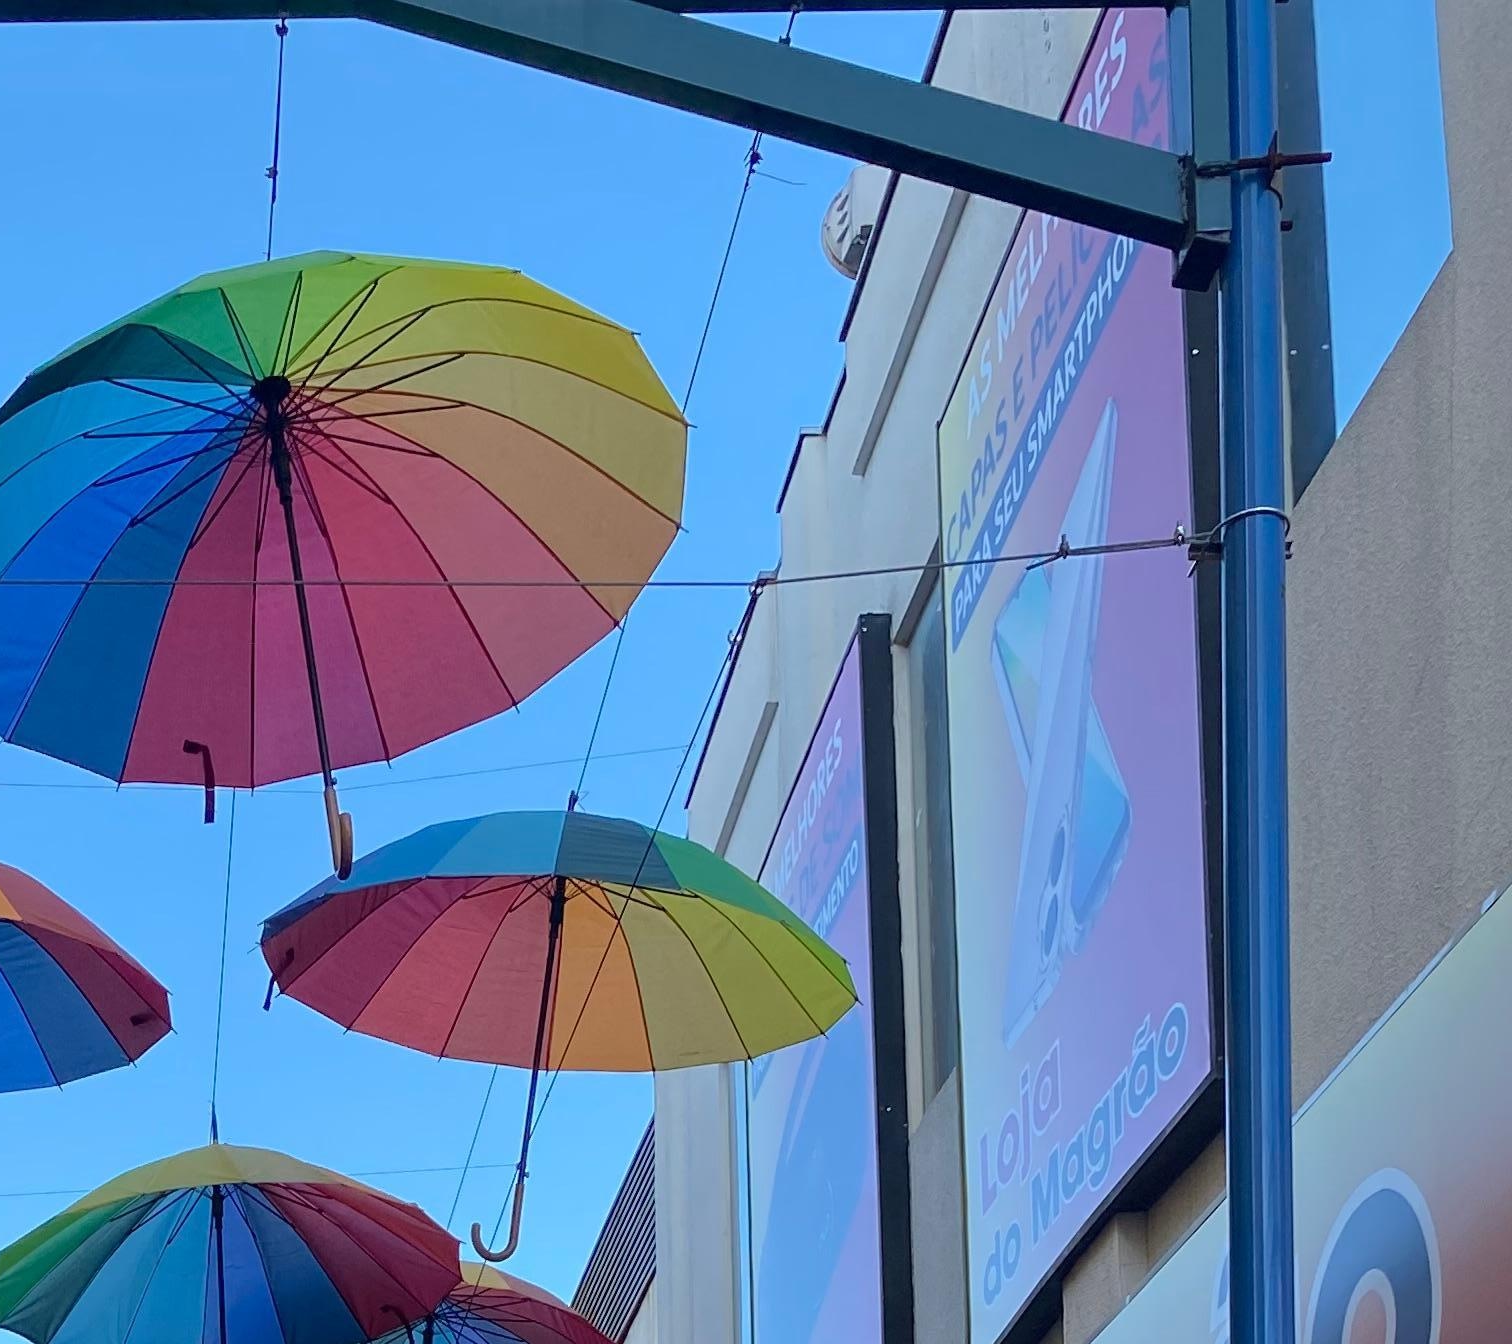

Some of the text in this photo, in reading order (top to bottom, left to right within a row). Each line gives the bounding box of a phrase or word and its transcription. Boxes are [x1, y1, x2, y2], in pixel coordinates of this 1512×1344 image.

[966, 10, 1127, 439] AS MELHRES
[947, 397, 1007, 562] CAPAS
[1013, 356, 1025, 416] E
[955, 236, 1135, 632] PARA SEU SMARTPHO
[980, 1038, 1062, 1214] Loja
[982, 1002, 1189, 1308] do Magrão
